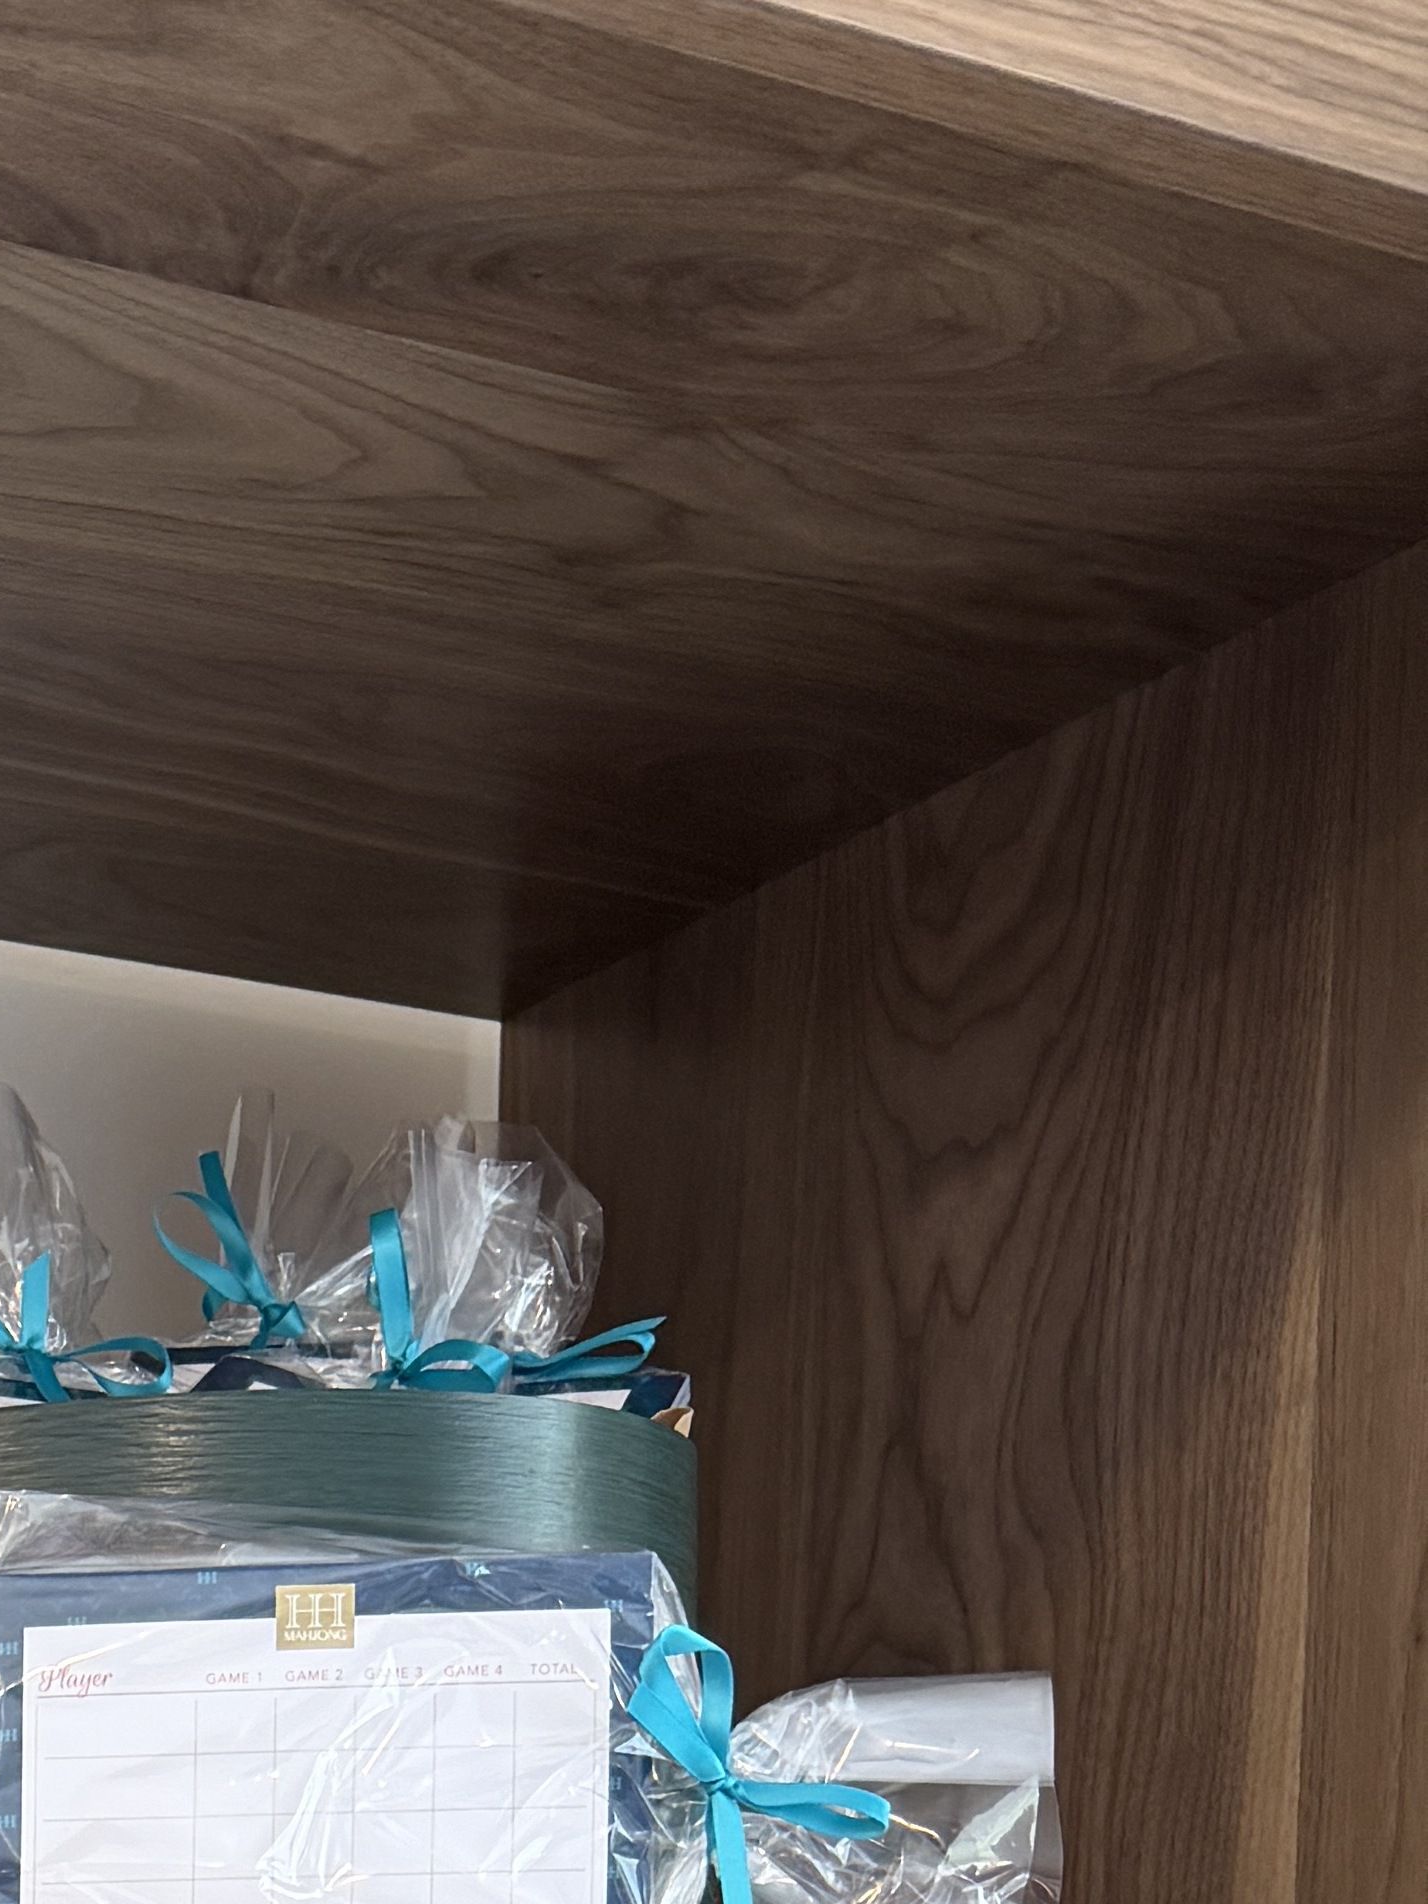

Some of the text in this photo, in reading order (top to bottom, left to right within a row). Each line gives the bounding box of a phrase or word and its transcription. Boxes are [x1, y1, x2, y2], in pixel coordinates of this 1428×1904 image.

[283, 1629, 347, 1642] MAHJONG
[38, 1665, 113, 1698] Player
[205, 1672, 251, 1685] GAME
[284, 1669, 330, 1683] GAME
[334, 1668, 345, 1682] 2
[443, 1665, 489, 1678] GAME
[493, 1664, 504, 1677] 4
[530, 1662, 579, 1676] TOTAL
